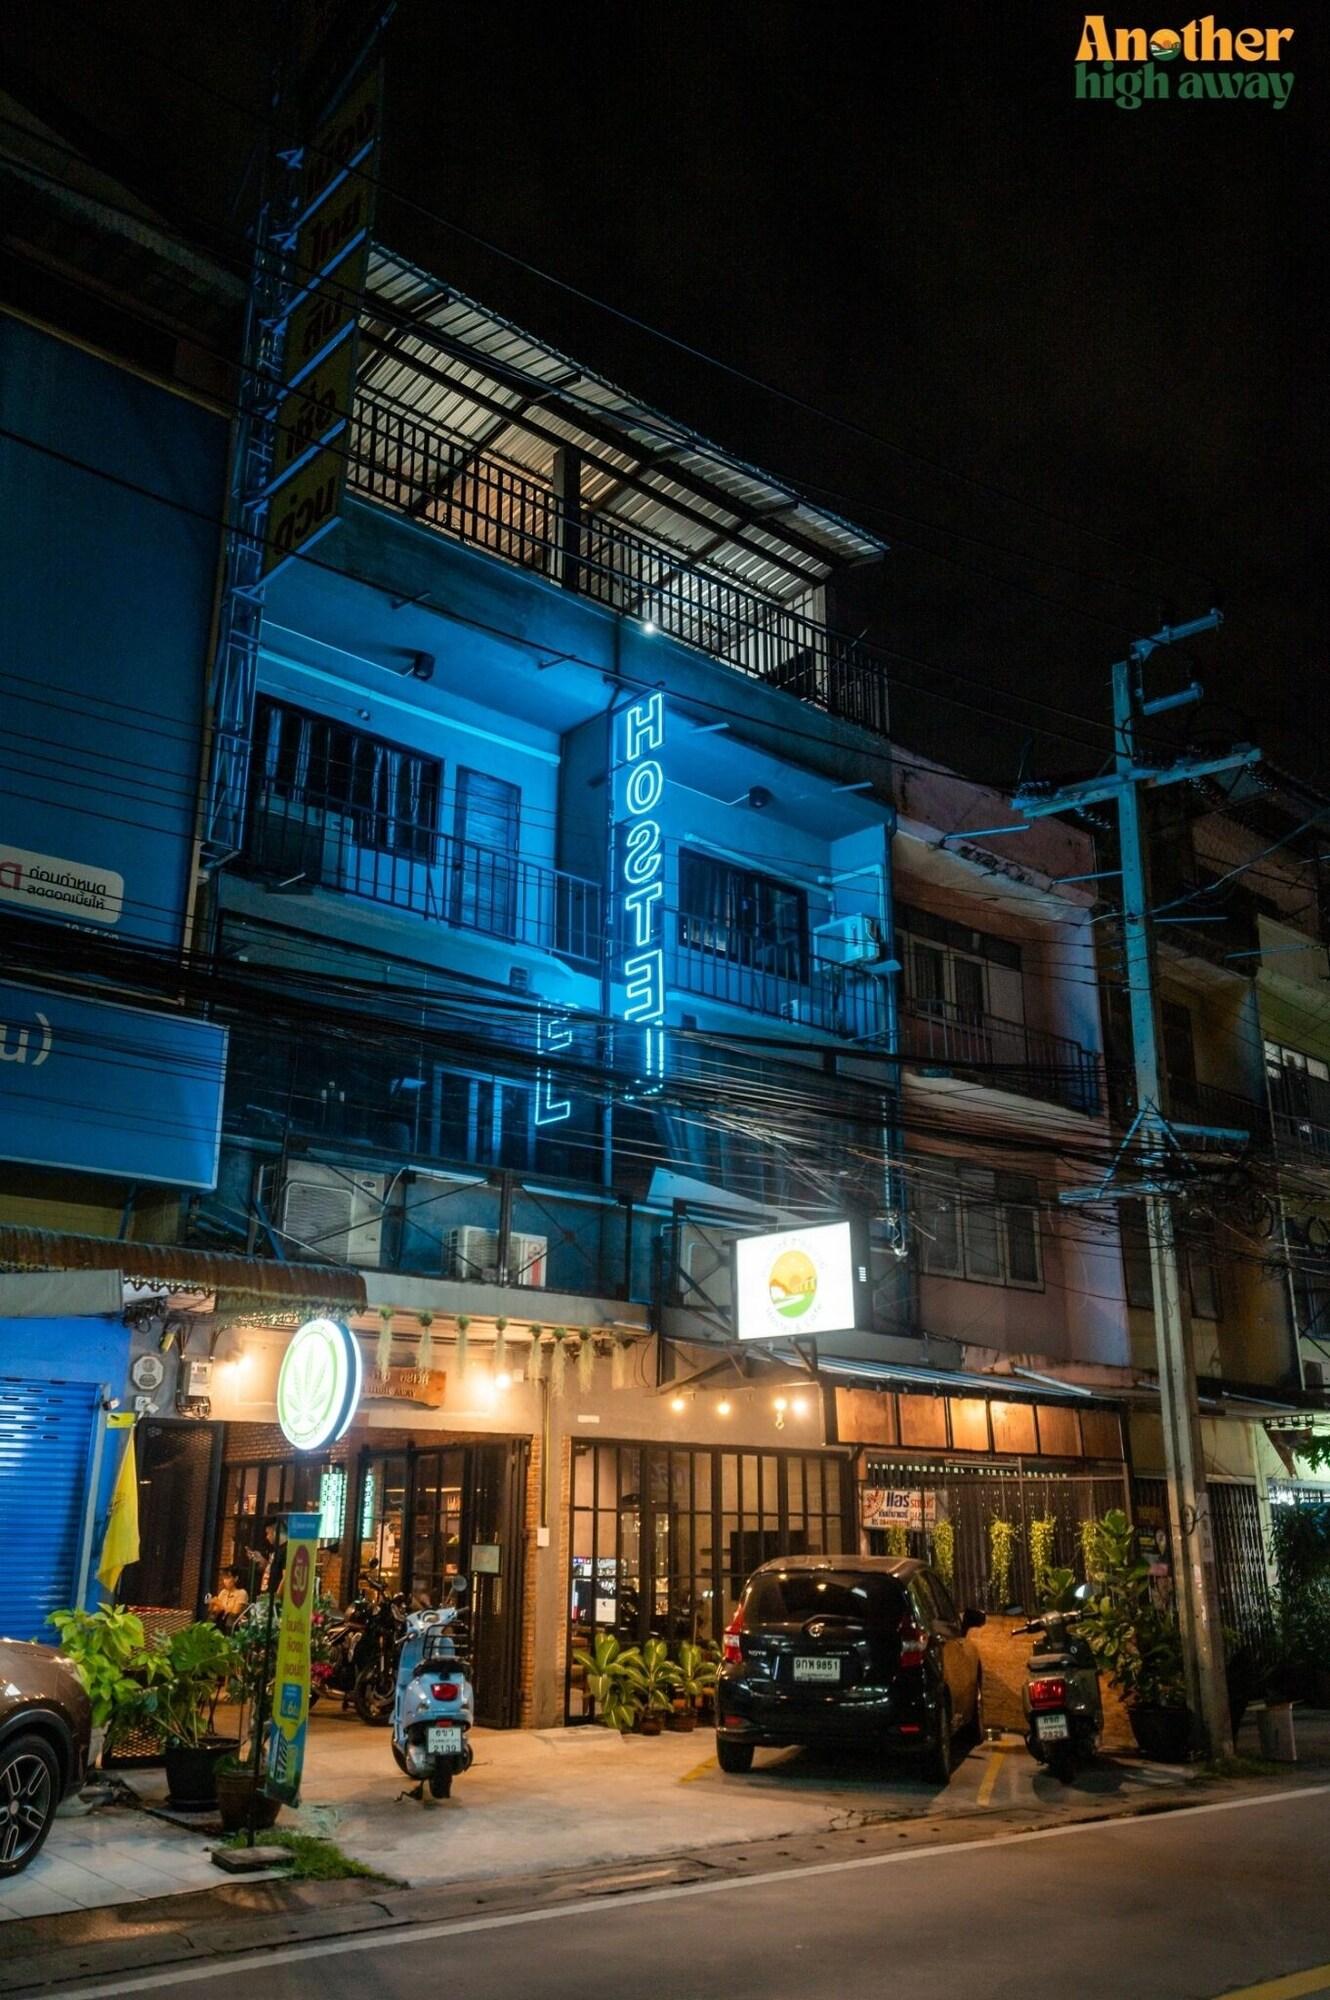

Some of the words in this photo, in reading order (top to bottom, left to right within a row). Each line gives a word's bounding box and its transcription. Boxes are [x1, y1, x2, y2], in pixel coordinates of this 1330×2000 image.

[274, 475, 337, 556] ด่วน
[29, 866, 107, 896] ก่อนกำหนด
